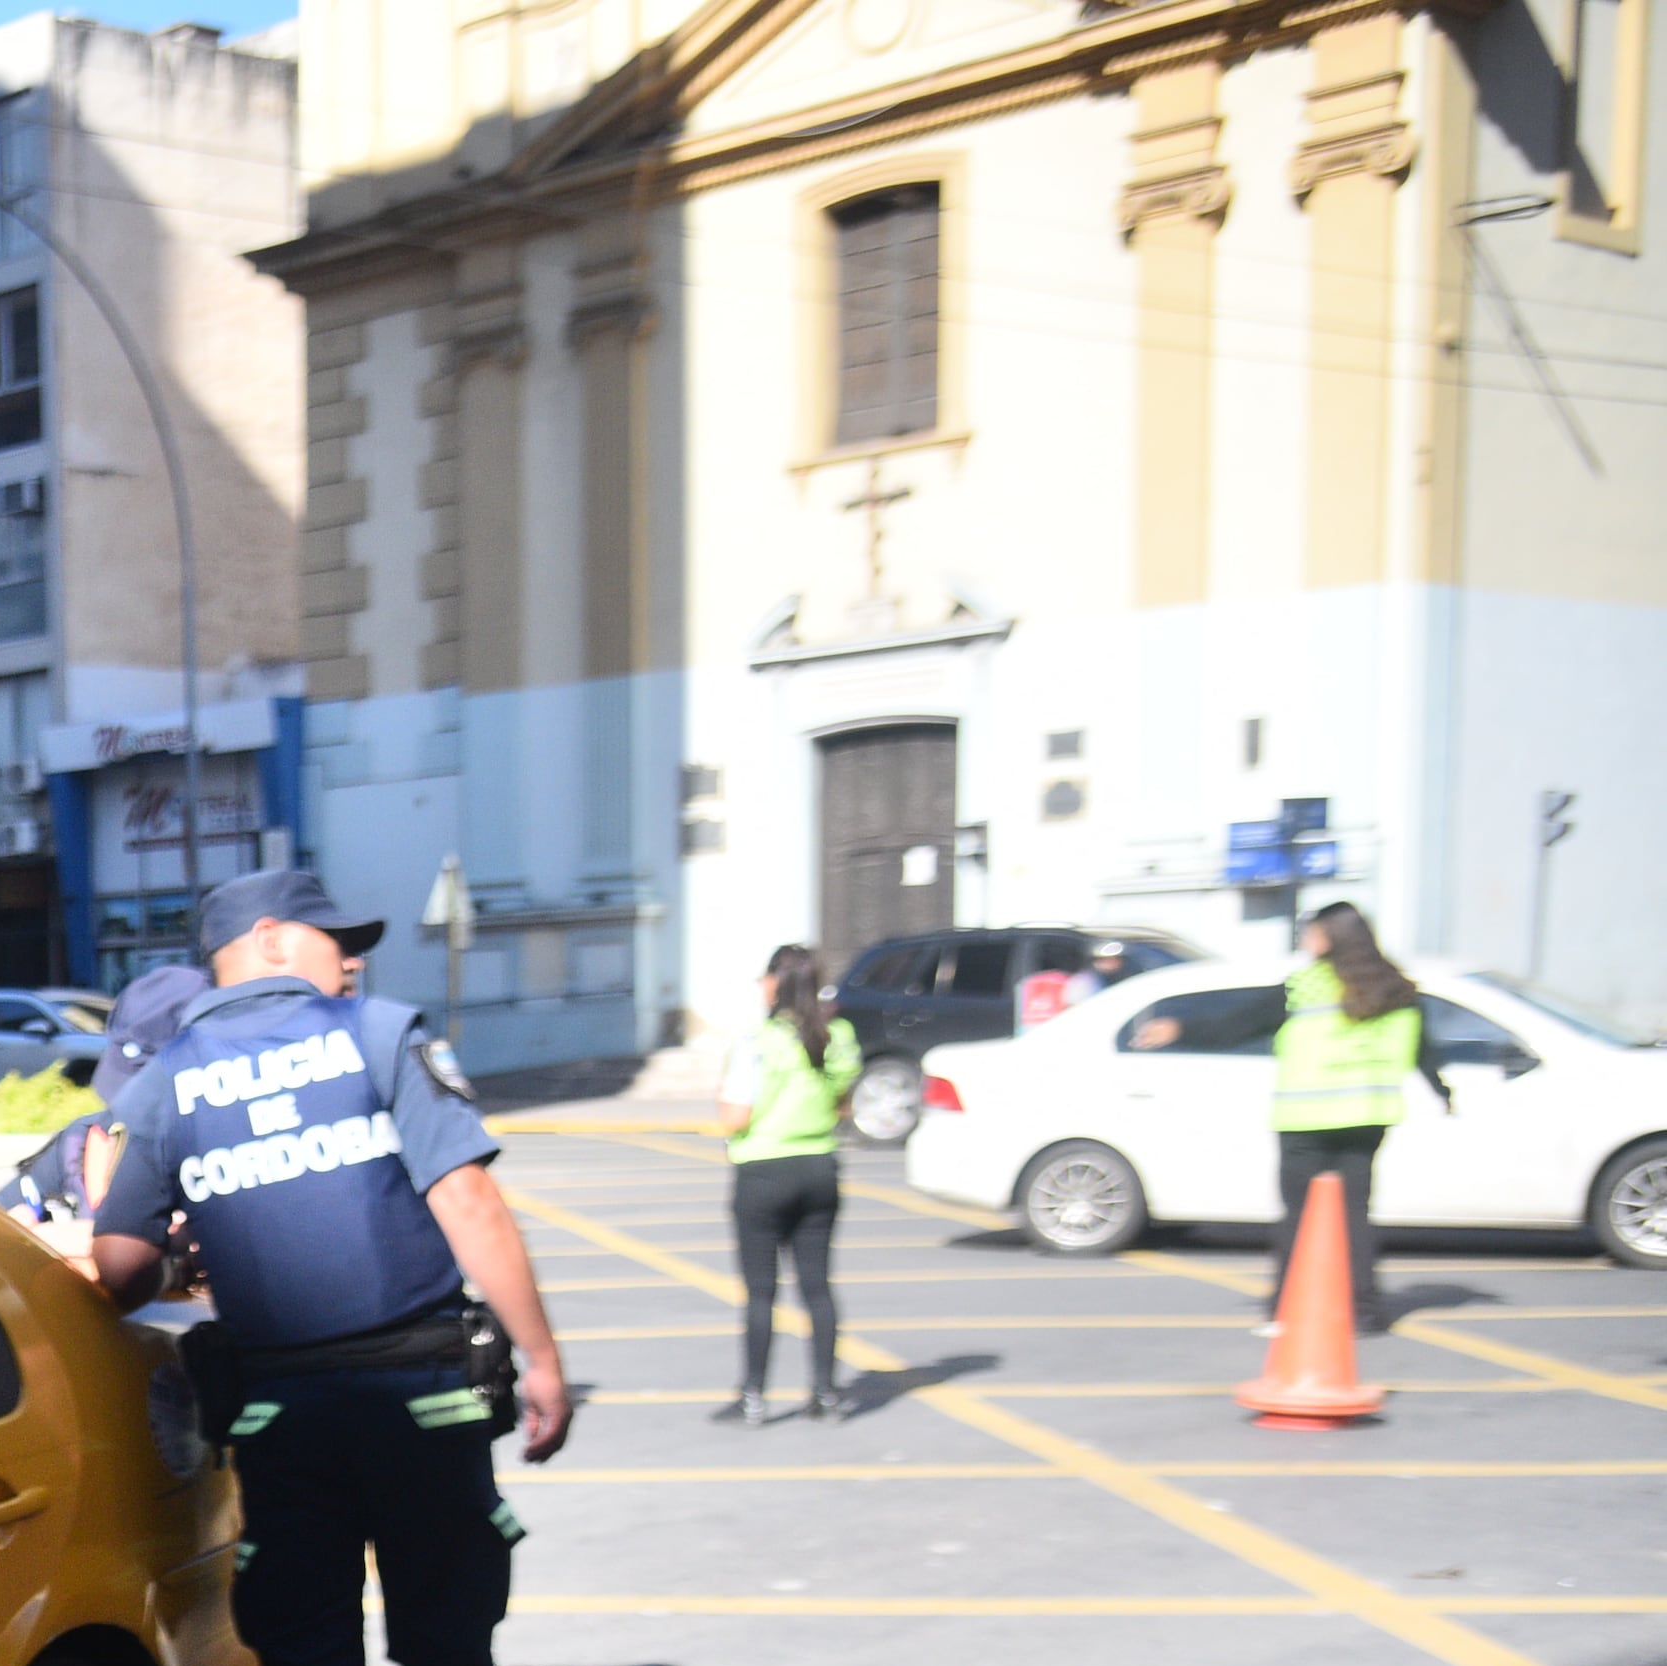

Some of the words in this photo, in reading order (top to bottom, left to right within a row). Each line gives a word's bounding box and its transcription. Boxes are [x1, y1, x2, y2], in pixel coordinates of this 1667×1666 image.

[174, 1029, 365, 1115] POLICIA
[247, 1093, 302, 1136] DE
[179, 1110, 403, 1203] CORDOBA
